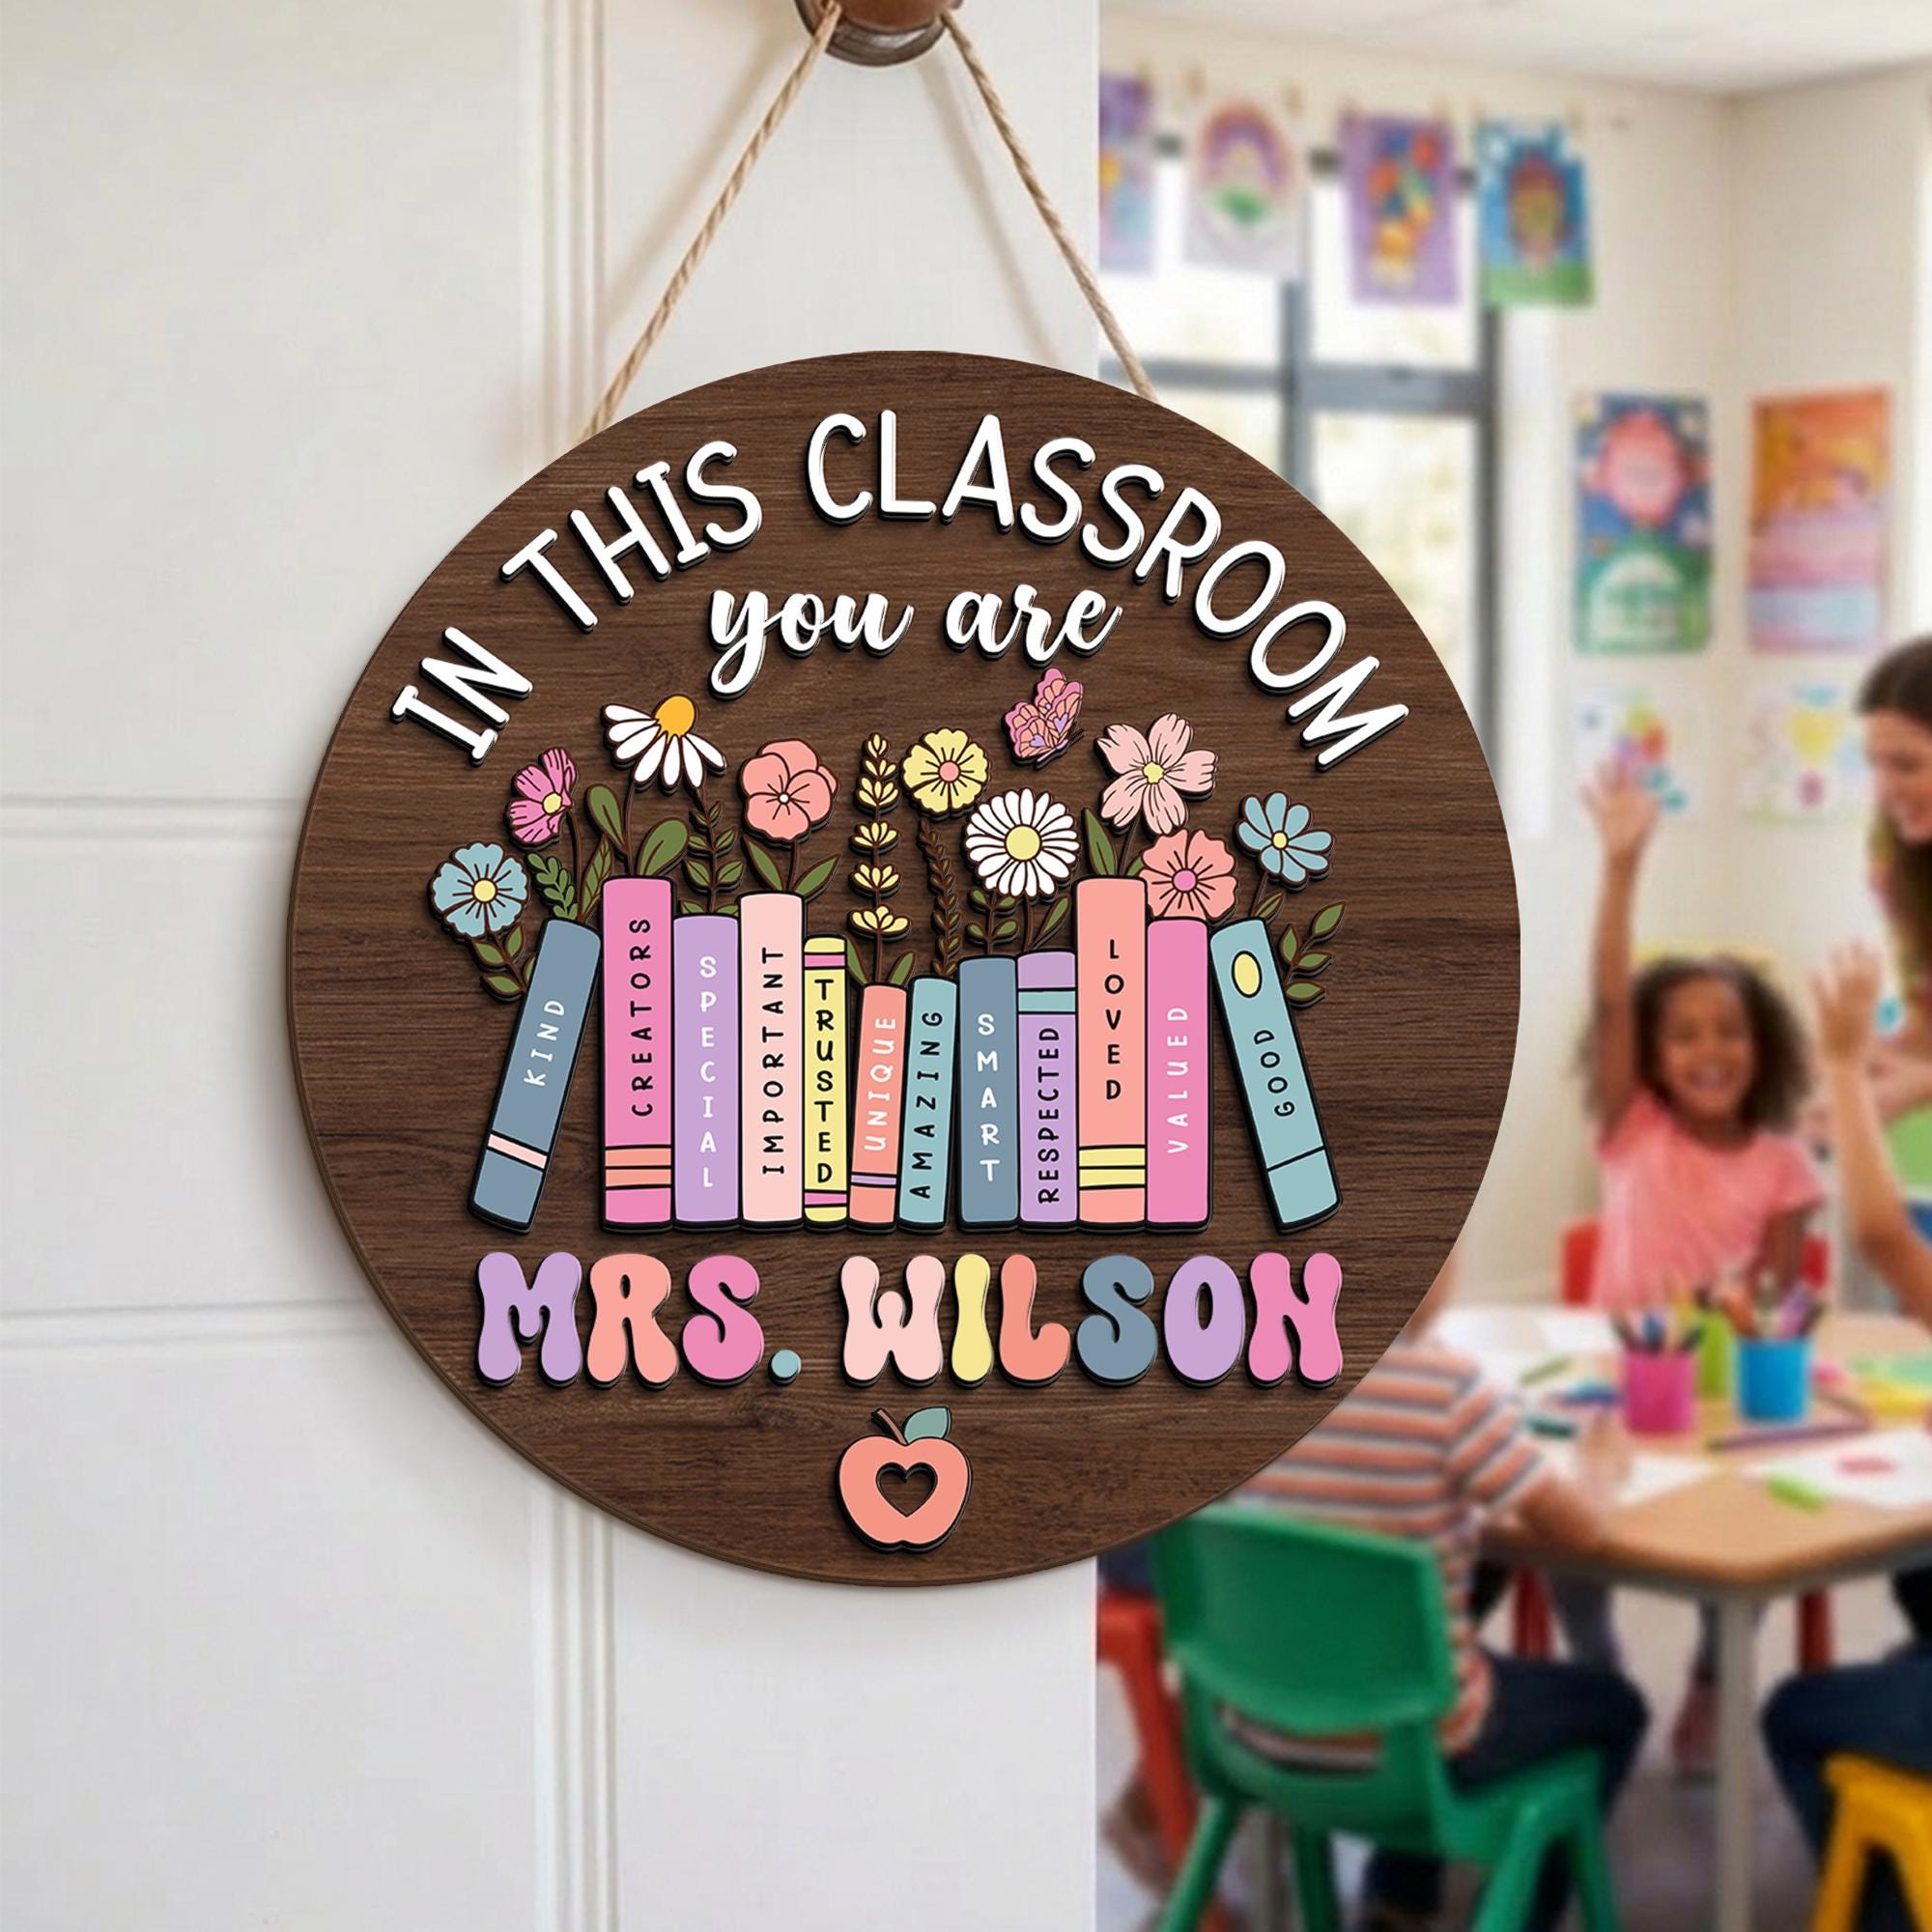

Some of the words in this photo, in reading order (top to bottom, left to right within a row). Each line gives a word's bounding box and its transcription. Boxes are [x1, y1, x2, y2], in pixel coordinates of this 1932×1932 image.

[389, 626, 533, 763] IN
[499, 440, 763, 631] THIS
[808, 410, 1409, 767] CLASSROOM
[708, 589, 914, 698] you
[944, 583, 1122, 667] are
[523, 1000, 565, 1087] KIND
[629, 919, 654, 1117] CREATORS
[699, 955, 717, 1188] SPECIAL
[761, 947, 784, 1175] IMPORTANT
[814, 979, 835, 1183] TRUSTED
[864, 1017, 896, 1151] UNIQUE
[977, 1013, 1001, 1182] SMART
[1104, 939, 1124, 1100] LOVED
[1167, 1008, 1189, 1154] VALUED
[1253, 1030, 1295, 1118] GOOD
[909, 1011, 943, 1199] AMAZING
[1037, 1027, 1060, 1204] RESPECTED
[475, 1251, 803, 1389] MRS.
[839, 1252, 1345, 1388] WILSON
